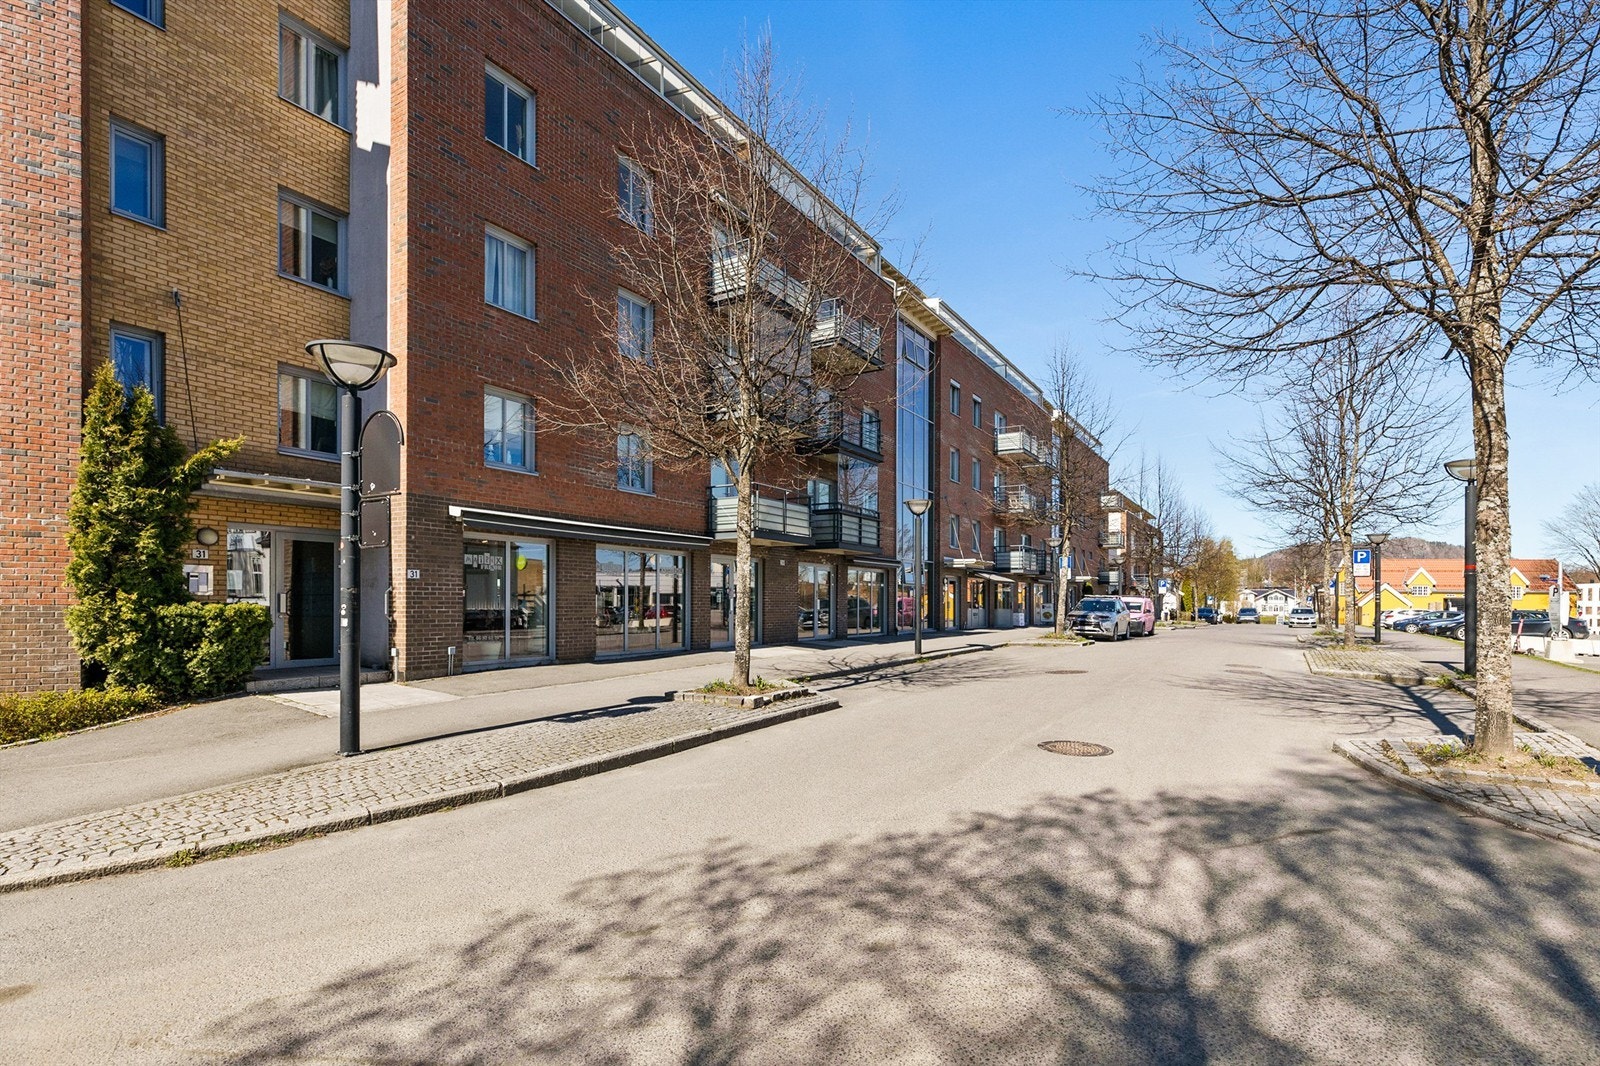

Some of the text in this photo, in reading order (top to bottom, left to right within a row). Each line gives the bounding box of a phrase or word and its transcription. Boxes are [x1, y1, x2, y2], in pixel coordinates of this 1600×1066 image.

[196, 550, 206, 558] 31
[1357, 551, 1367, 562] P
[410, 570, 418, 578] 31
[1552, 587, 1558, 597] P
